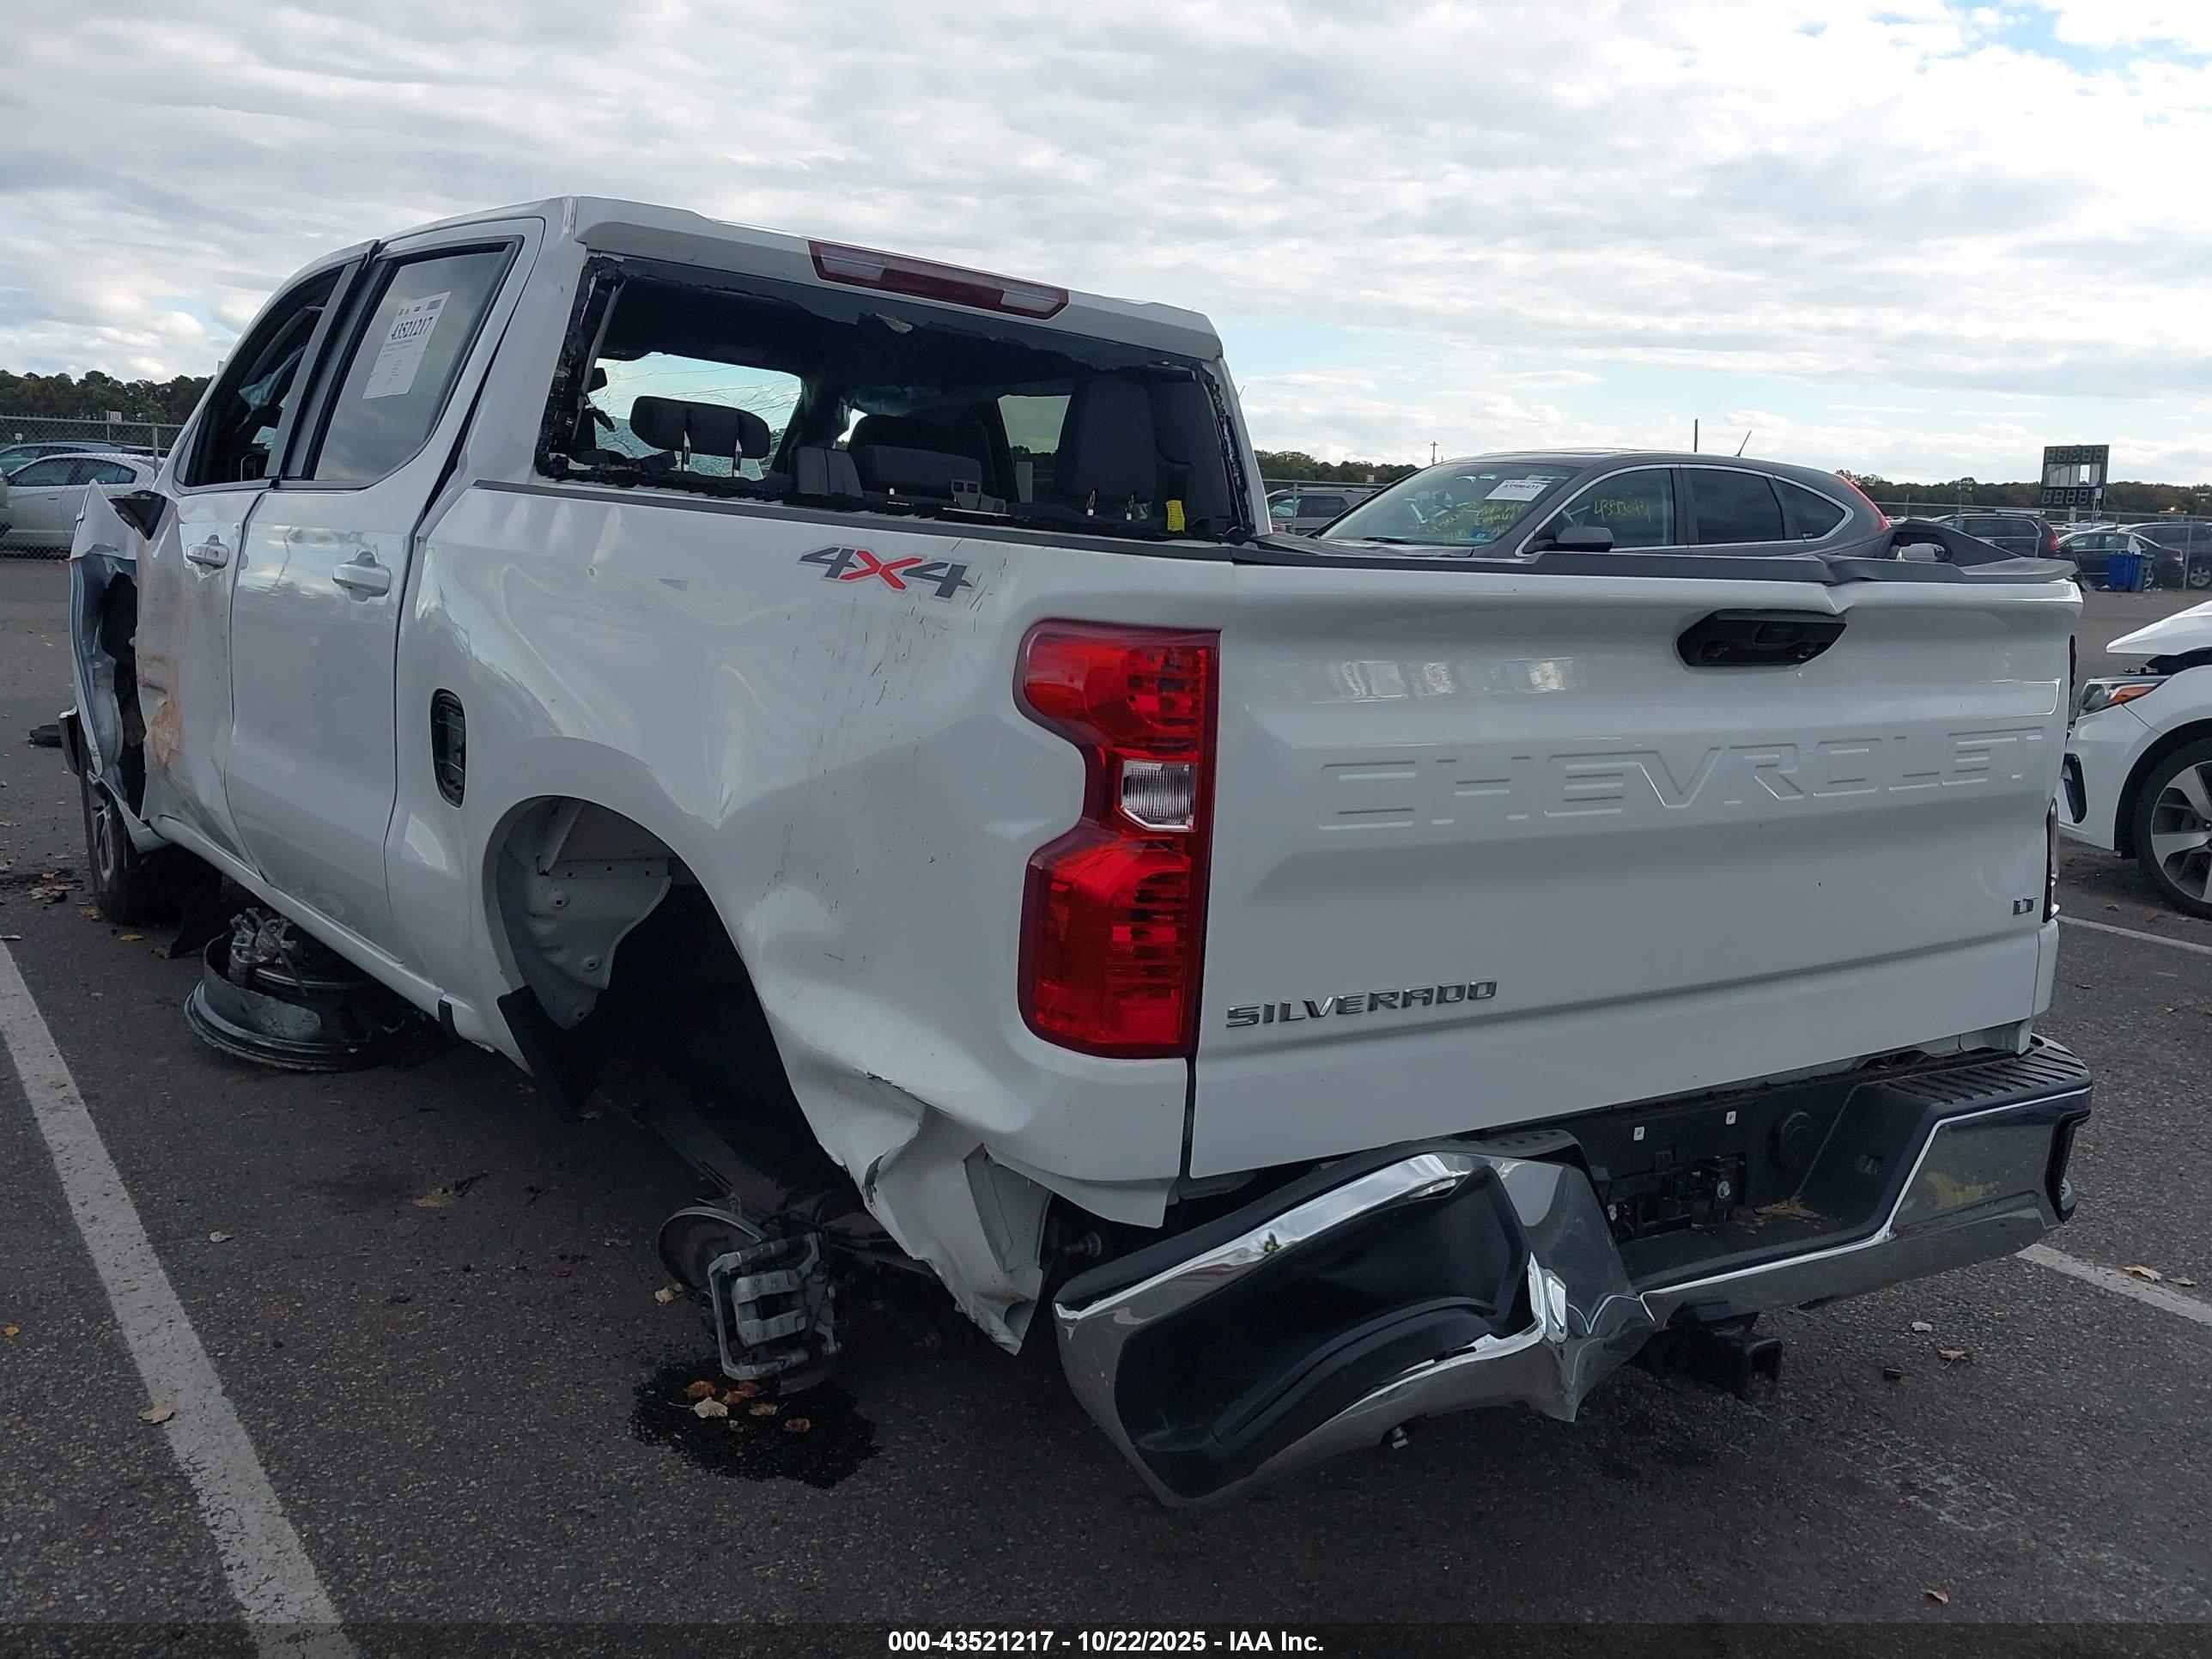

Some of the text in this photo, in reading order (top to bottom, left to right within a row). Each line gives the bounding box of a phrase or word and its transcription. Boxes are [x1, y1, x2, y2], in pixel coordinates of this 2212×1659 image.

[391, 316, 434, 340] 43521217
[1317, 726, 2045, 830] CHEVROLET
[2012, 896, 2039, 915] LT
[1224, 978, 1498, 1029] SILVERADO
